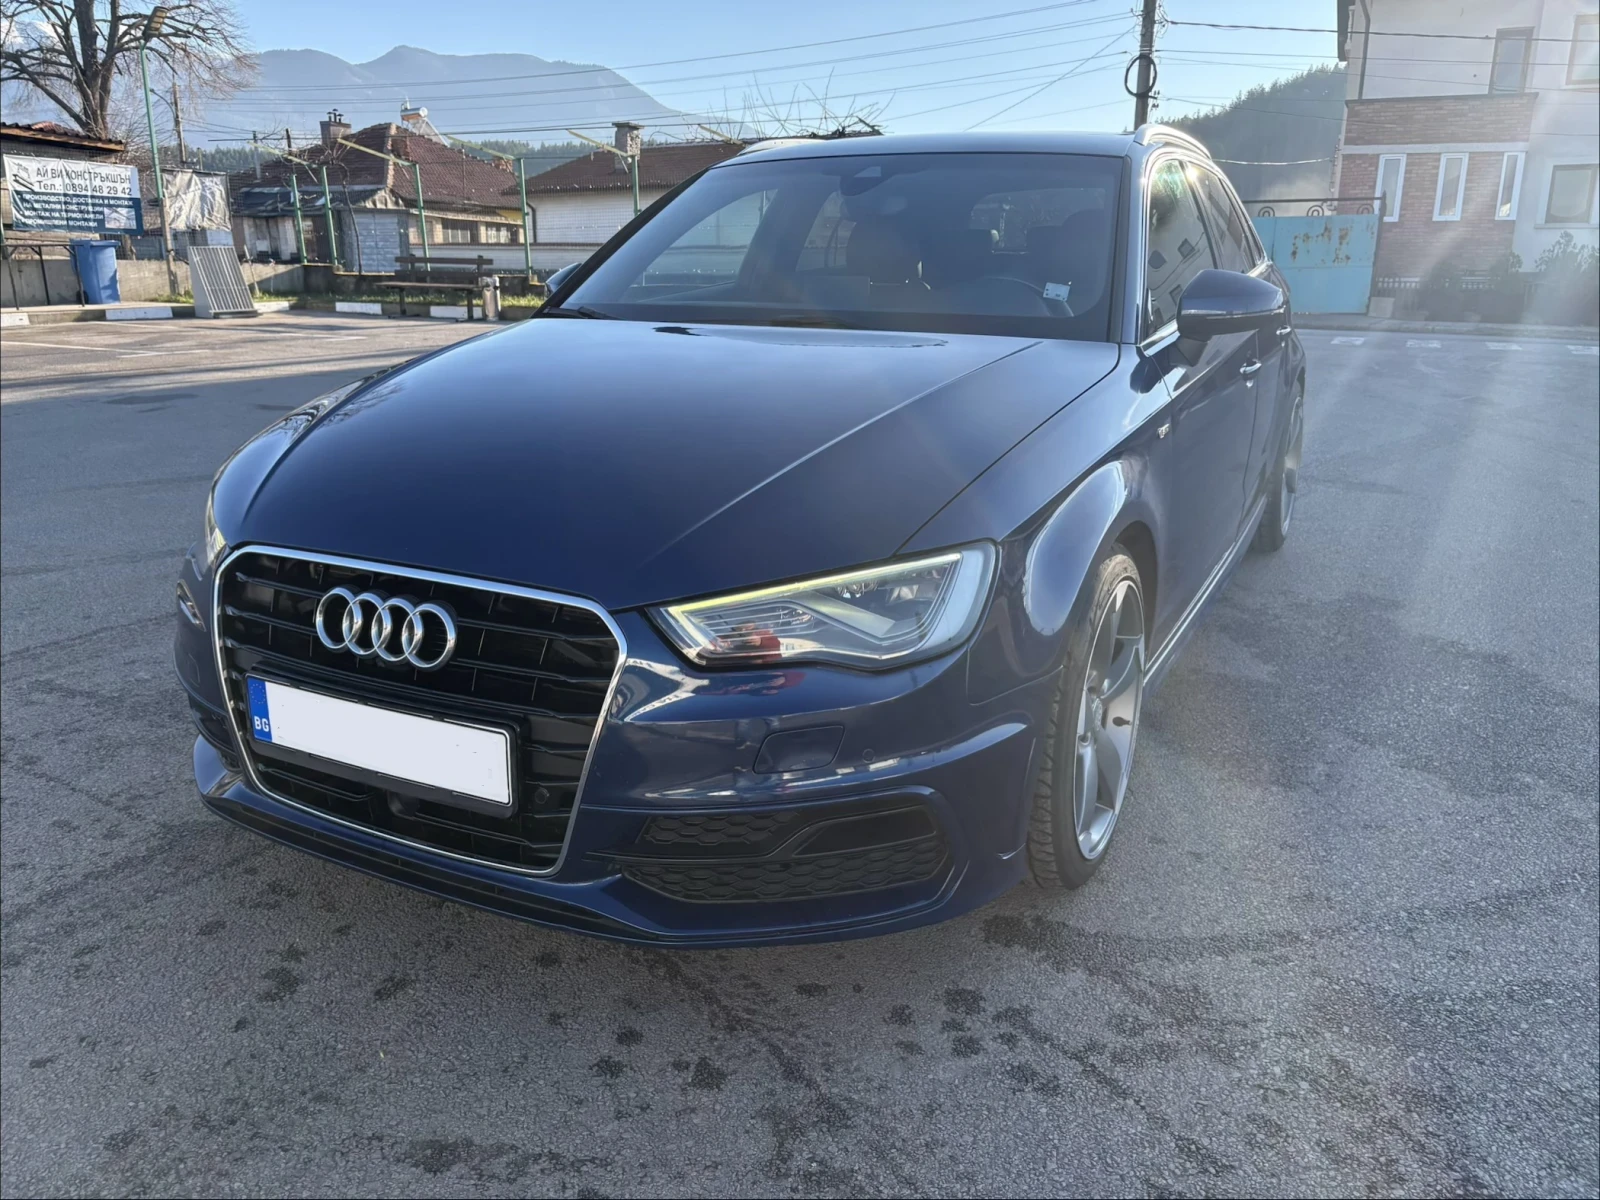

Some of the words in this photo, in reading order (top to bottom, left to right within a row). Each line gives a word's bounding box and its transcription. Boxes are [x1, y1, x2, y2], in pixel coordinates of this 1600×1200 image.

[36, 165, 49, 178] АЙ
[51, 168, 63, 179] ВИ
[65, 169, 131, 184] КОНСТРЪКШЪН
[37, 180, 62, 191] Тел.:
[65, 182, 89, 193] 0894
[92, 185, 104, 195] 48
[106, 185, 118, 195] 29
[121, 187, 132, 196] 42
[22, 193, 71, 203] ПРОИЗВОДСТО,
[254, 715, 269, 732] BG
